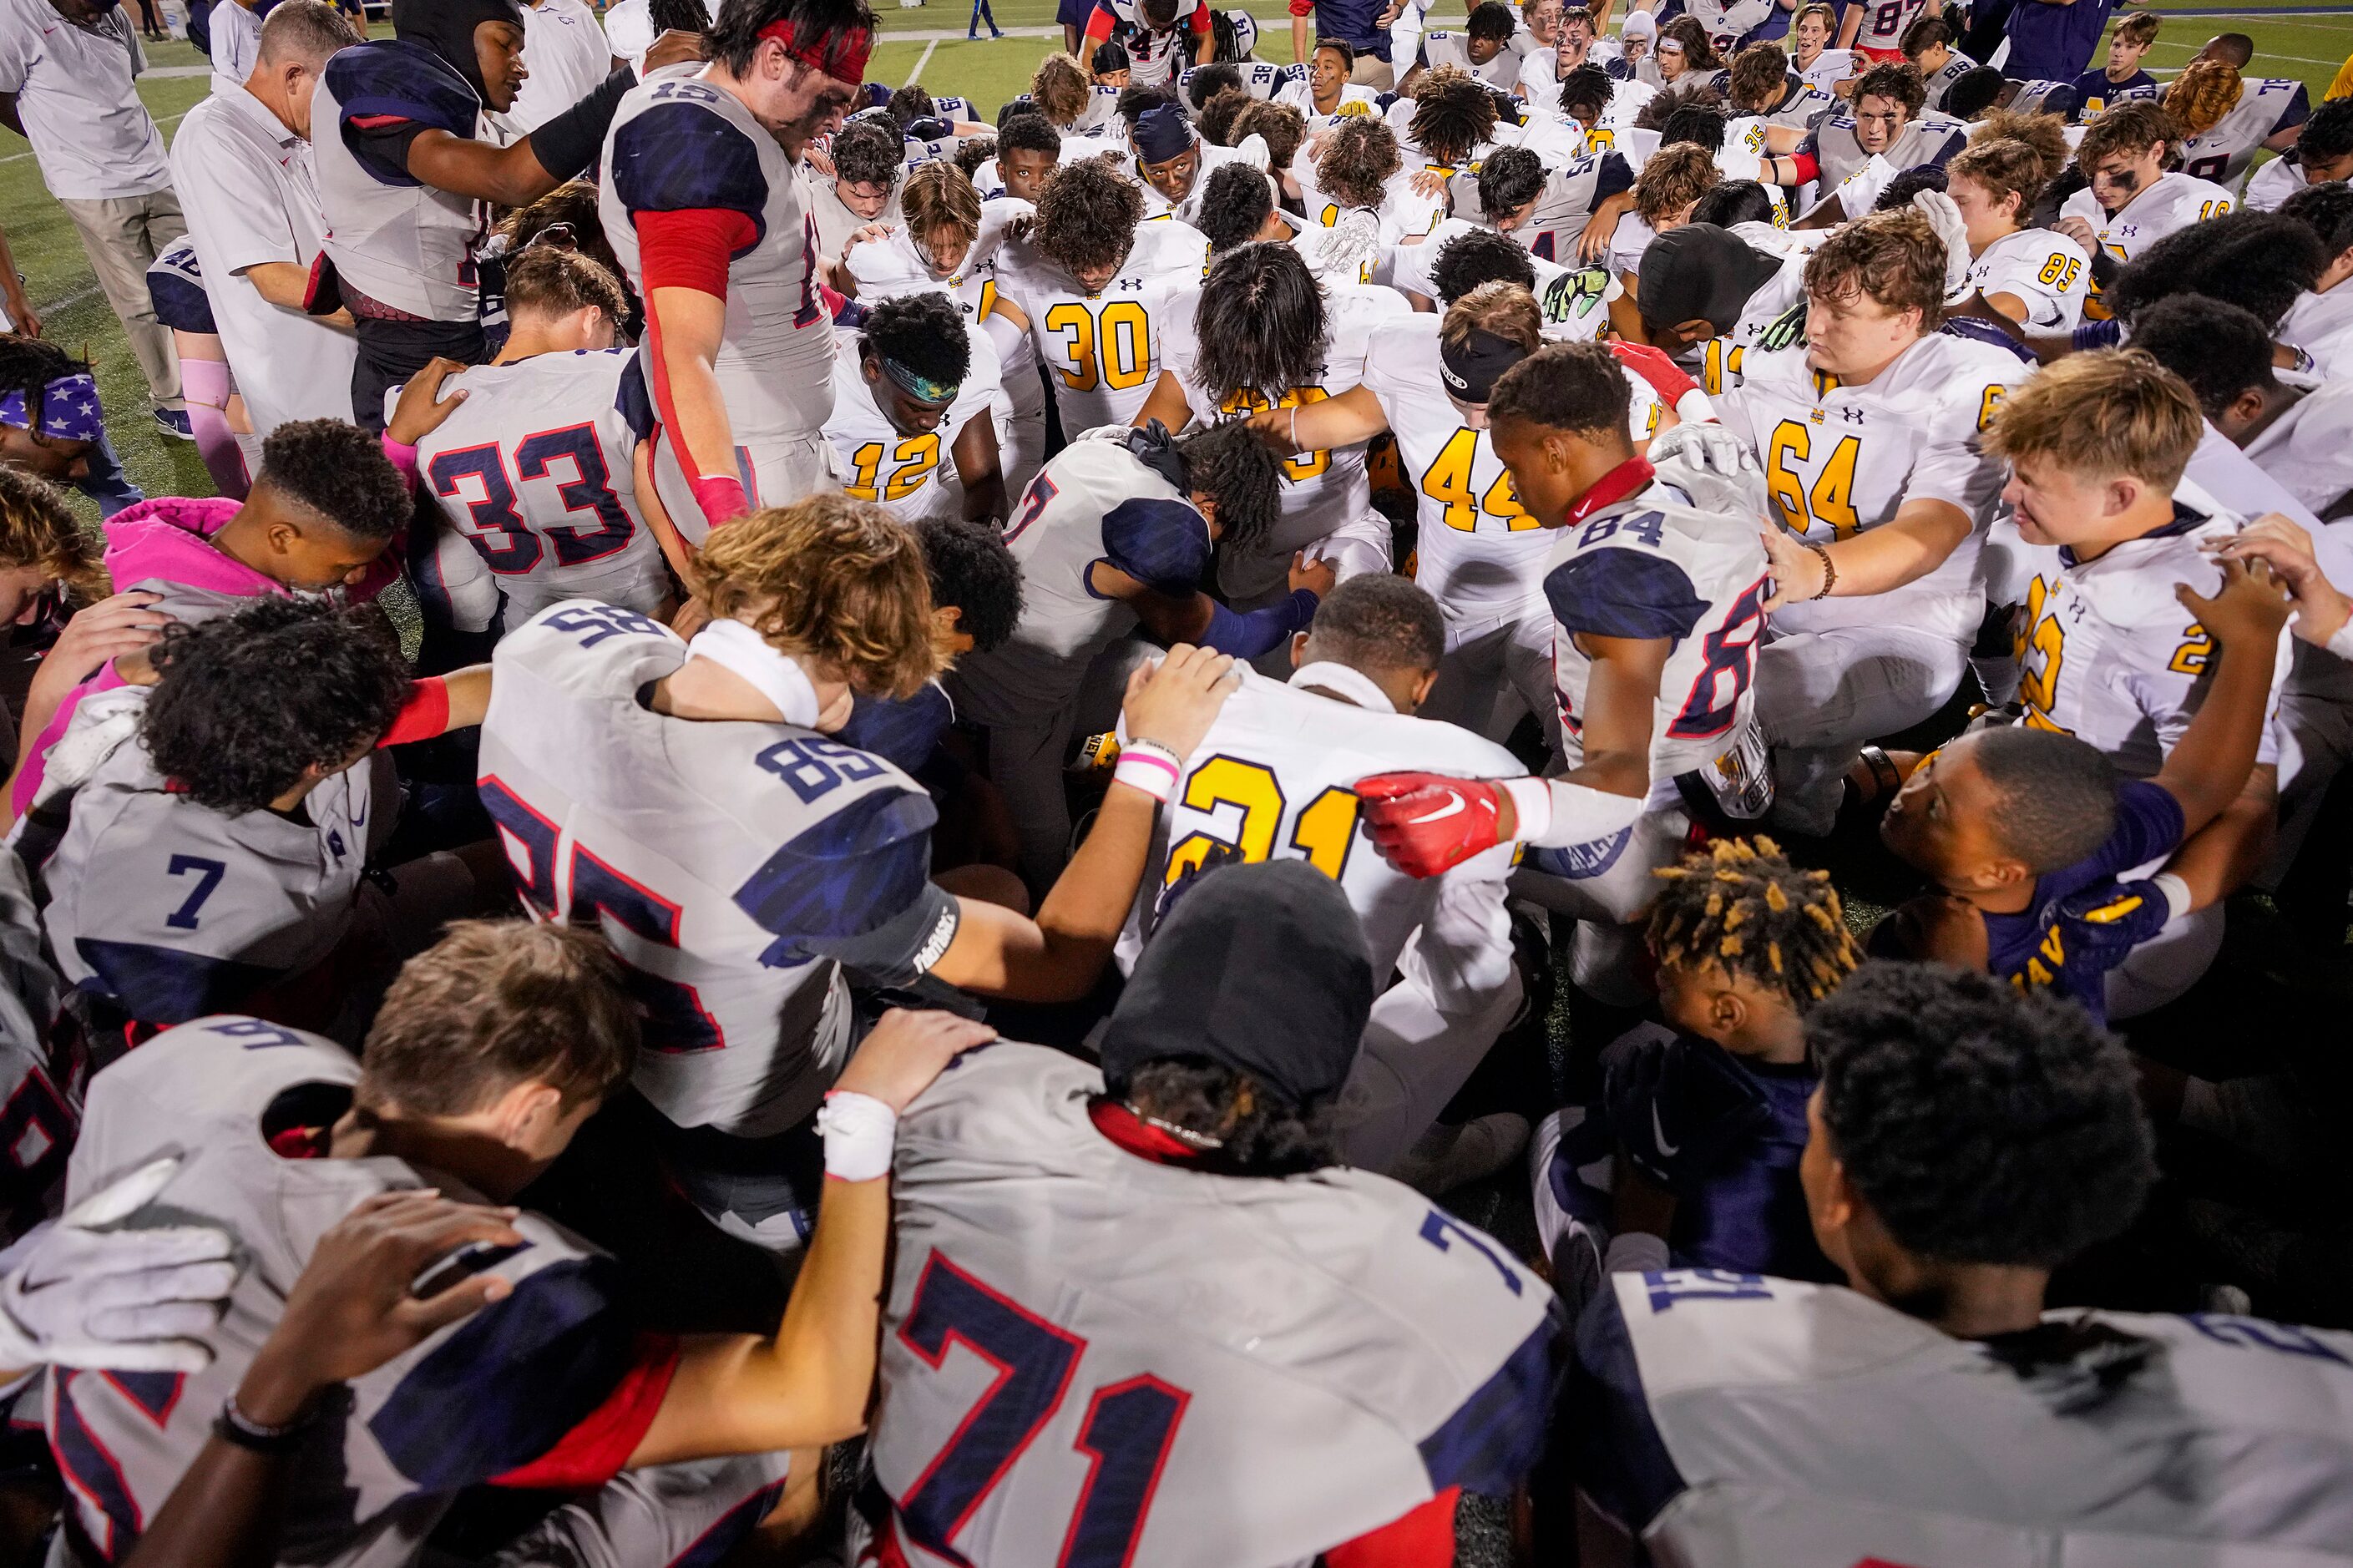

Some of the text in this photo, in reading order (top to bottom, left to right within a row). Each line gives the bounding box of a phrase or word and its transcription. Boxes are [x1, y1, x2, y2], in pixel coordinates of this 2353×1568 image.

[651, 83, 719, 103] 15
[1744, 124, 1766, 154] 35
[2037, 251, 2082, 293] 85
[1045, 299, 1151, 392] 30
[428, 420, 636, 575] 33
[843, 431, 942, 502] 12
[1766, 417, 1865, 544] 64
[1578, 510, 1664, 555] 84
[755, 736, 890, 805] 85
[164, 853, 226, 929] 7
[896, 1247, 1201, 1568] 71
